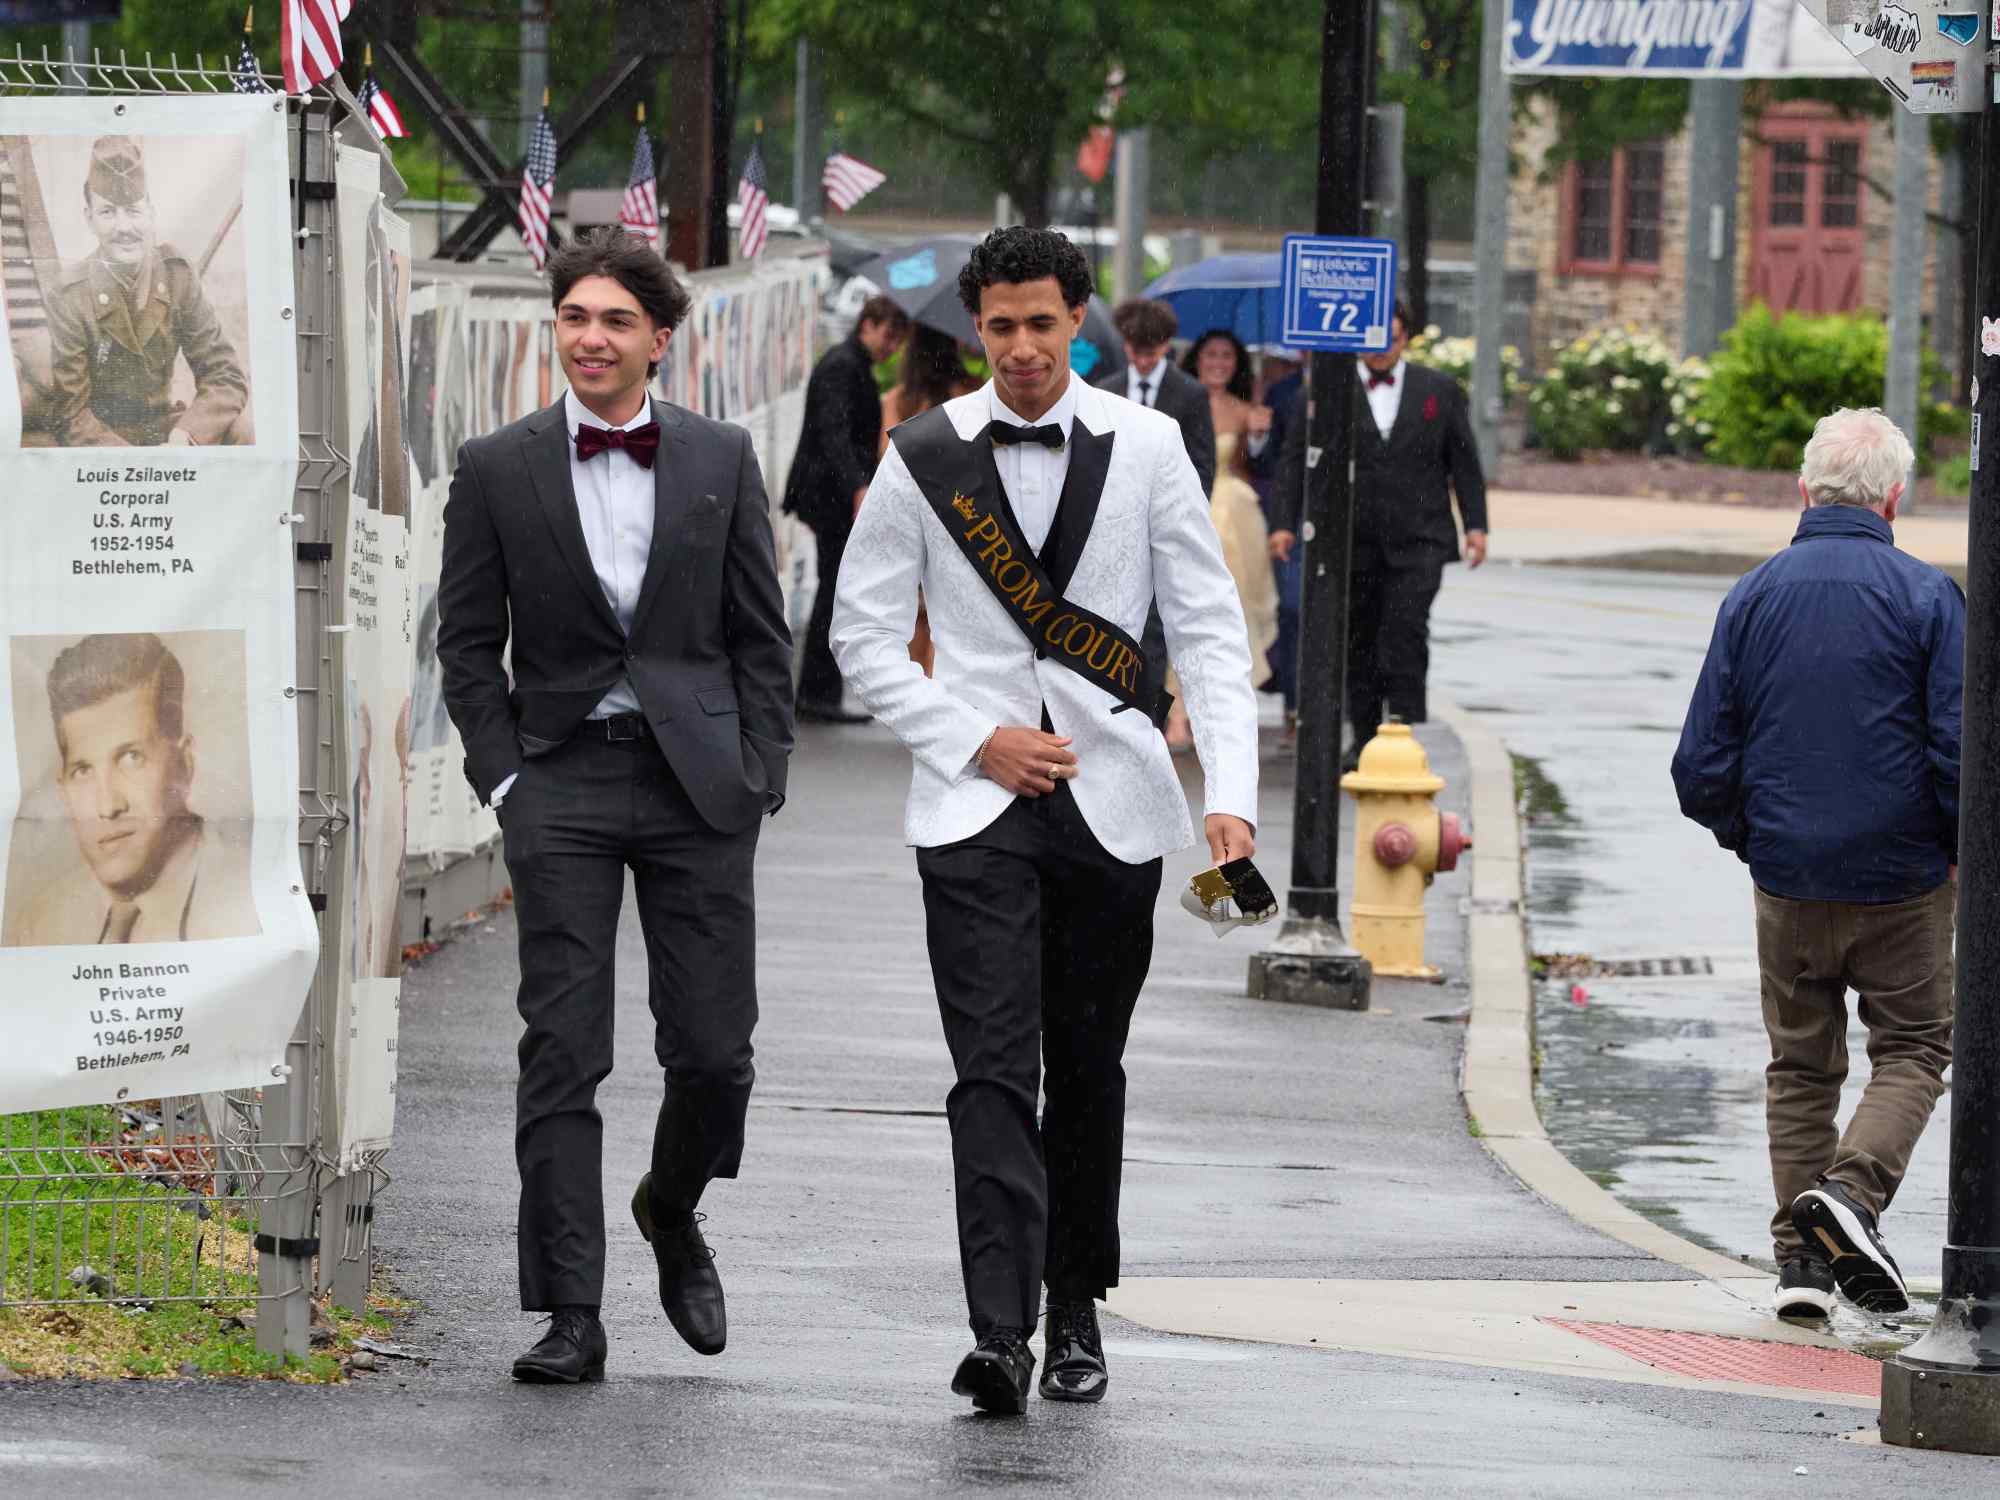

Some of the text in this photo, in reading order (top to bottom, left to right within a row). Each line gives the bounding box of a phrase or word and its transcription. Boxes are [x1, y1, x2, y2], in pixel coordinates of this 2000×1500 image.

[1318, 302, 1359, 332] 72
[77, 467, 197, 483] Louis Zsilavetz
[99, 490, 170, 508] Corporal
[93, 513, 174, 531] U.S. Army
[90, 535, 175, 552] 1952-1954
[72, 558, 194, 577] Bethlehem, PA
[963, 513, 1142, 694] PROM COURT
[72, 961, 190, 980] John Bannon
[99, 984, 167, 1002] Private
[90, 1006, 184, 1024] U.S. Army
[94, 1025, 183, 1046] 1946-1950
[77, 1043, 190, 1071] Bethlehem, PA
